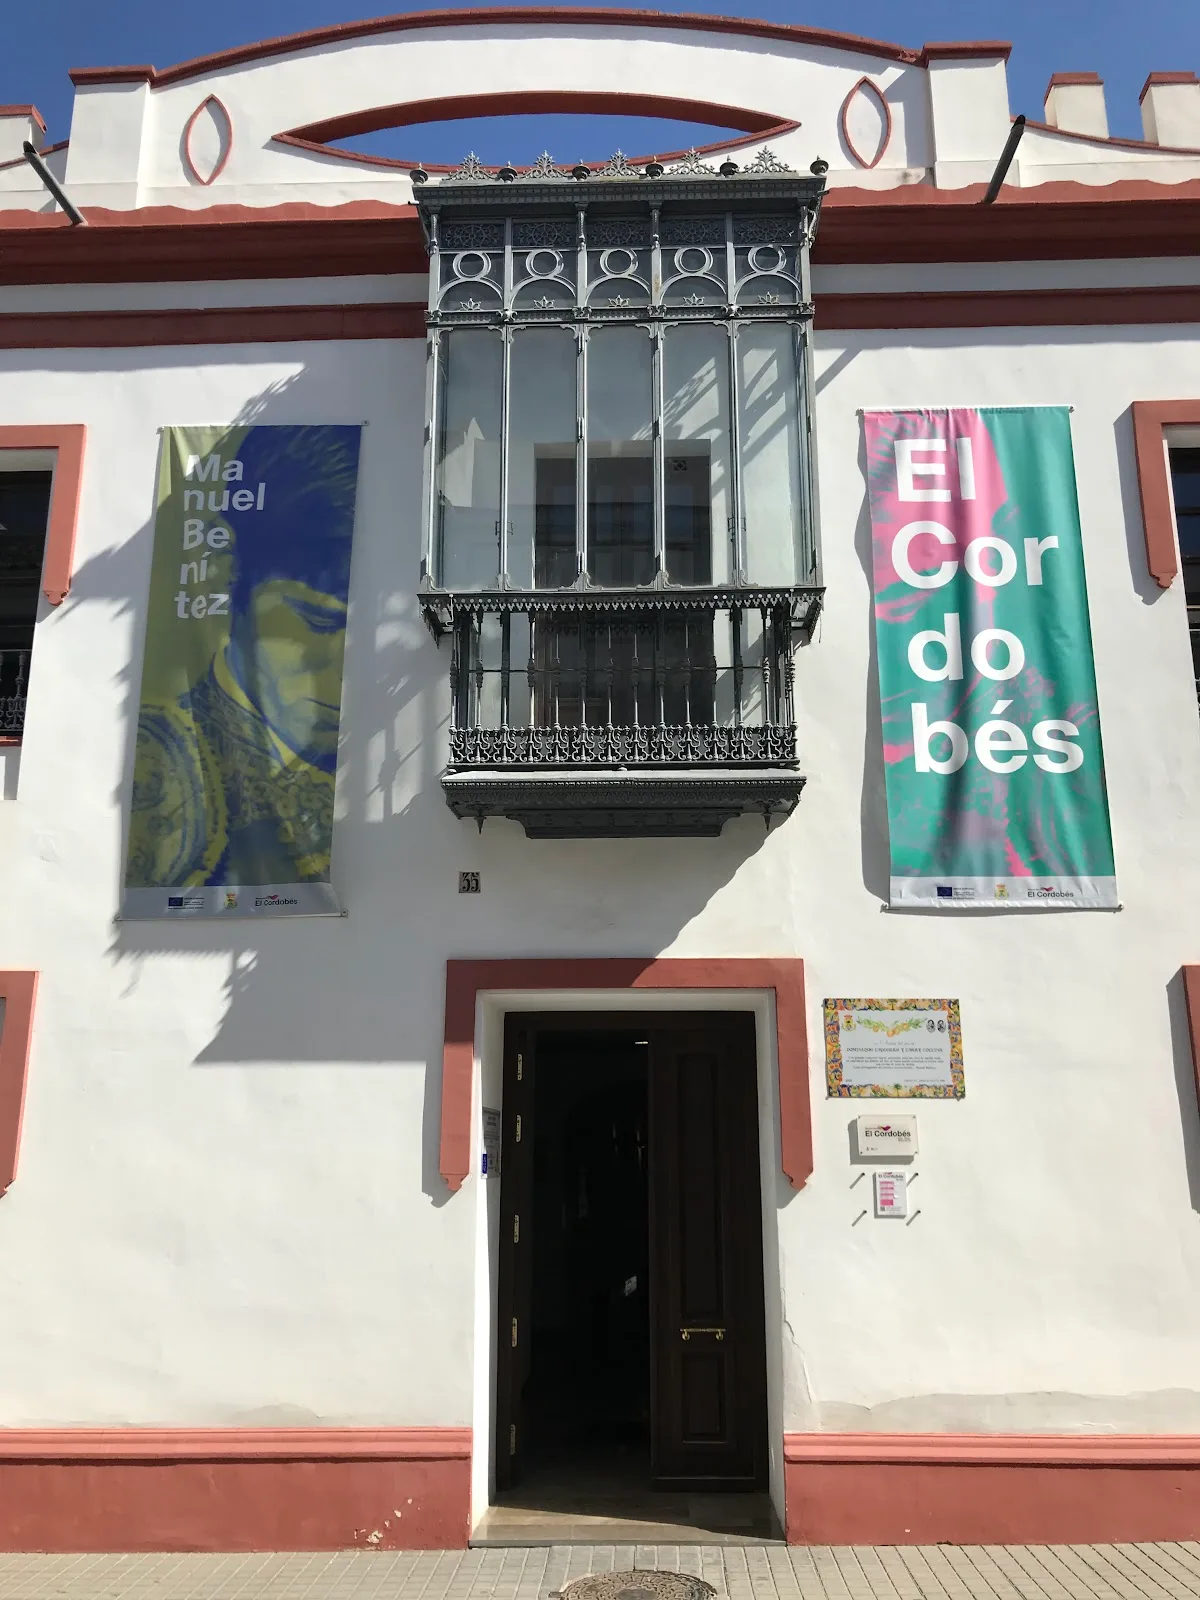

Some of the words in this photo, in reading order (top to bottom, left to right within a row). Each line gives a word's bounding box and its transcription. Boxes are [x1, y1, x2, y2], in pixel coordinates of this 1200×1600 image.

[184, 454, 244, 482] Ma
[893, 436, 977, 502] El
[183, 482, 266, 512] nuel
[182, 518, 230, 550] Be
[179, 551, 211, 585] ní
[890, 519, 1060, 589] Cor
[174, 590, 230, 619] tez
[907, 612, 1026, 682] do
[910, 699, 1085, 775] bés
[1037, 890, 1074, 898] Cordobés
[874, 1130, 911, 1138] Cordobés
